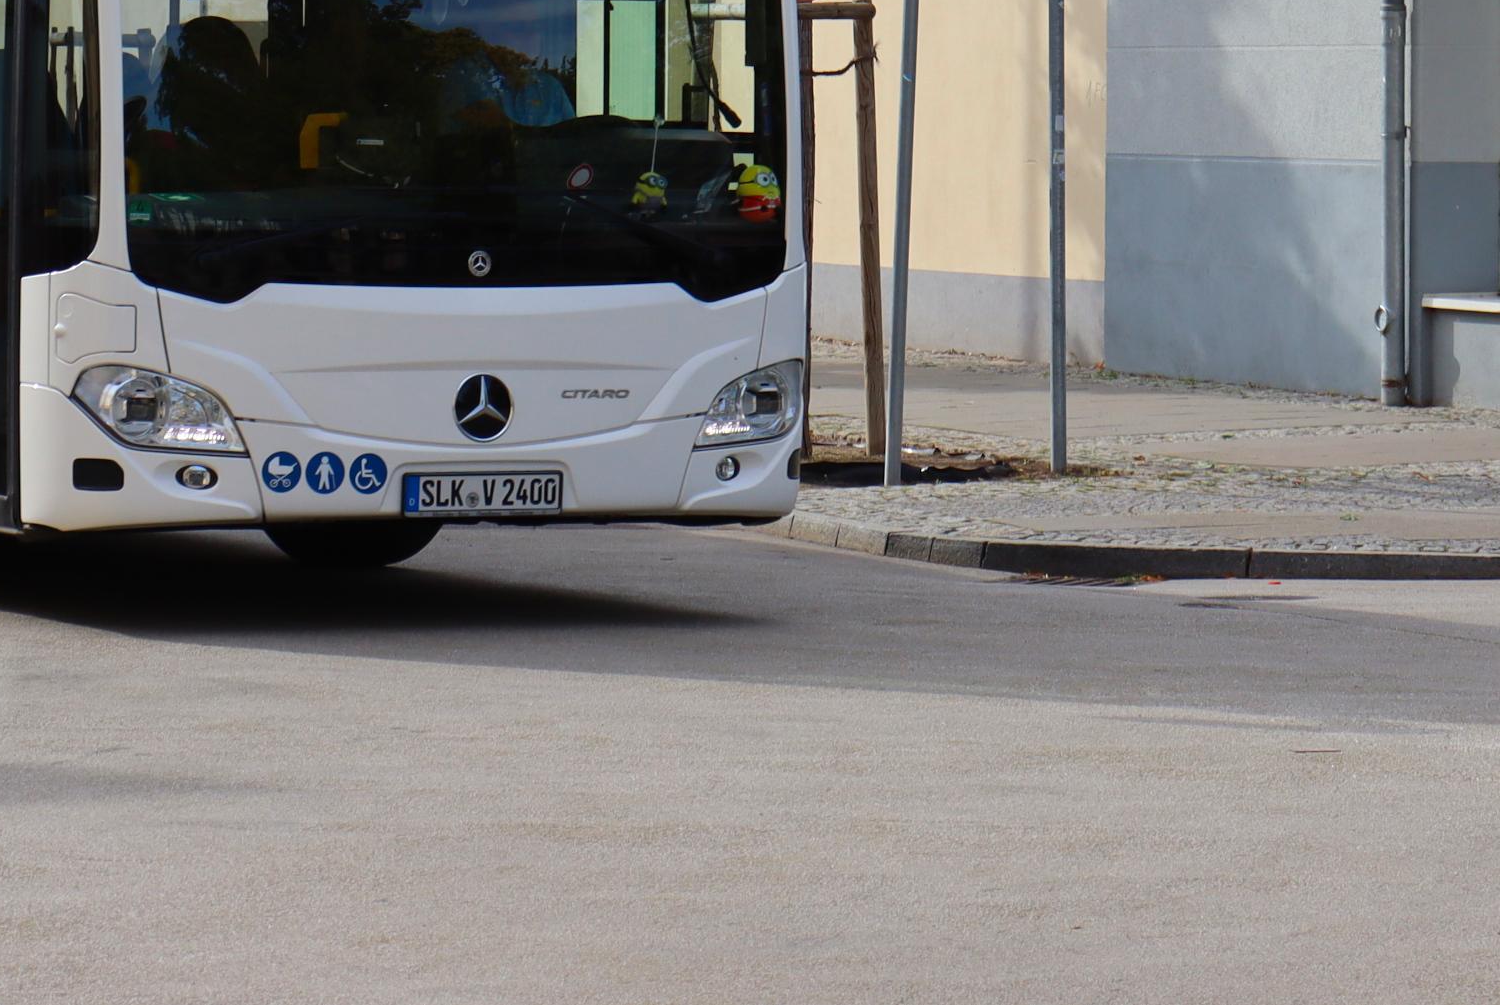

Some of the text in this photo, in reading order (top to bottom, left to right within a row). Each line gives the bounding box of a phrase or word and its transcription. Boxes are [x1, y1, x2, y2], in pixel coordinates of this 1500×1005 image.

[561, 389, 630, 399] CITARO
[421, 479, 464, 507] SLK
[483, 479, 496, 506] V
[502, 478, 556, 506] 2400
